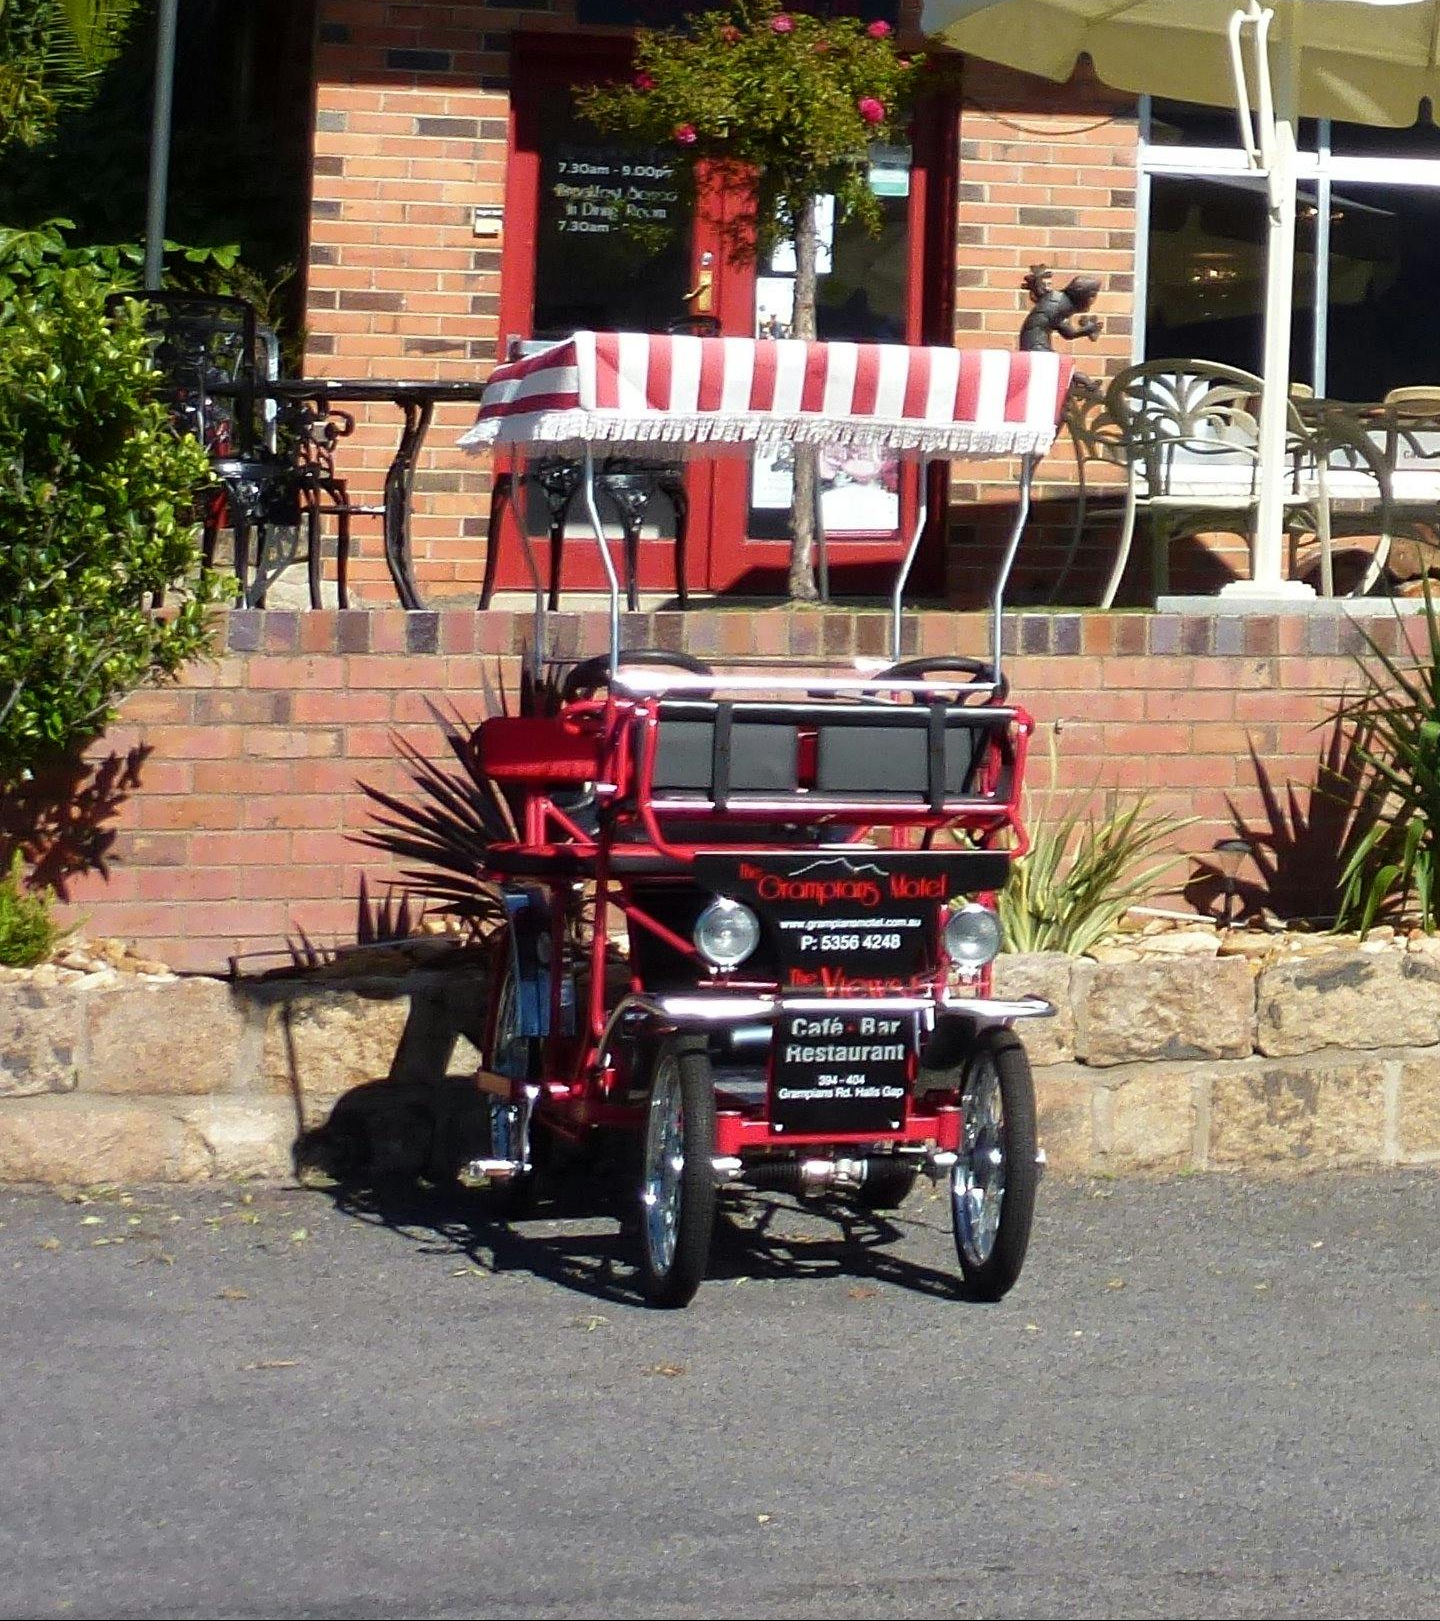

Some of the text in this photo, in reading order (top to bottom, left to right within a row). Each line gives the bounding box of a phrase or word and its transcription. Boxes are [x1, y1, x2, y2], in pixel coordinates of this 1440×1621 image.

[758, 875, 881, 906] Grampians
[890, 873, 948, 899] Motel
[801, 932, 901, 951] P: 5356 4248
[791, 1016, 901, 1038] Café Bar
[785, 1043, 905, 1063] Restaurant
[882, 1085, 904, 1099] Gap
